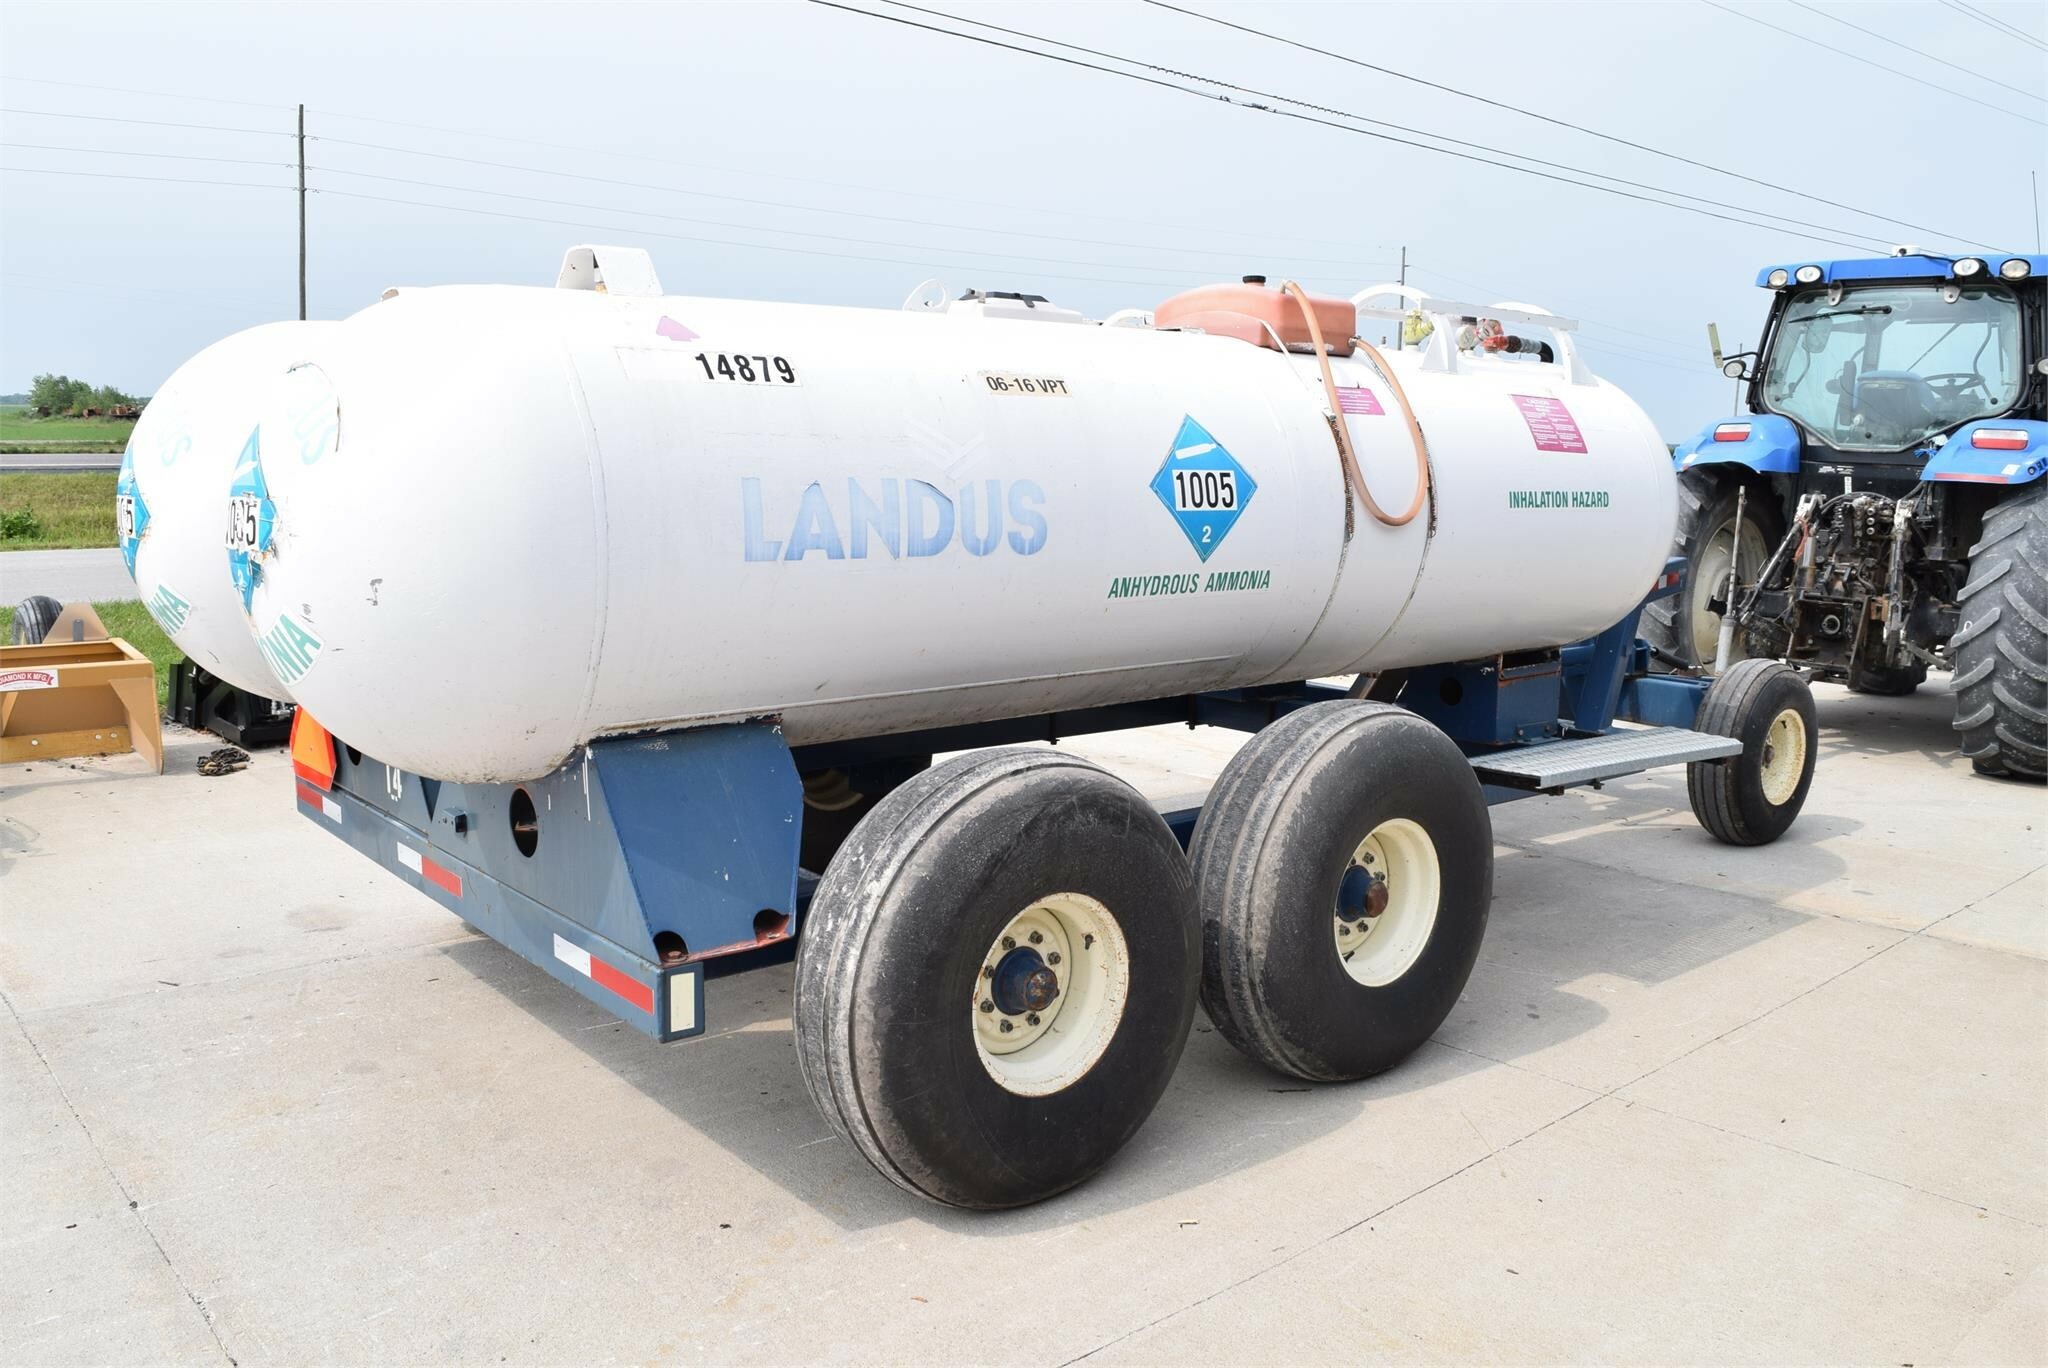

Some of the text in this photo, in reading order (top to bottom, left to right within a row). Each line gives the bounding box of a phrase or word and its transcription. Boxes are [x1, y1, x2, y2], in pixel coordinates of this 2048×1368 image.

[695, 353, 795, 384] 14879
[986, 376, 1067, 394] 06-16 VPT
[1175, 471, 1235, 509] 1005
[1509, 491, 1610, 508] INHALATION HAZARD
[741, 477, 1048, 562] LANDUS
[1201, 525, 1212, 543] 2
[1108, 570, 1271, 599] ANHYDROUS AMMONIA
